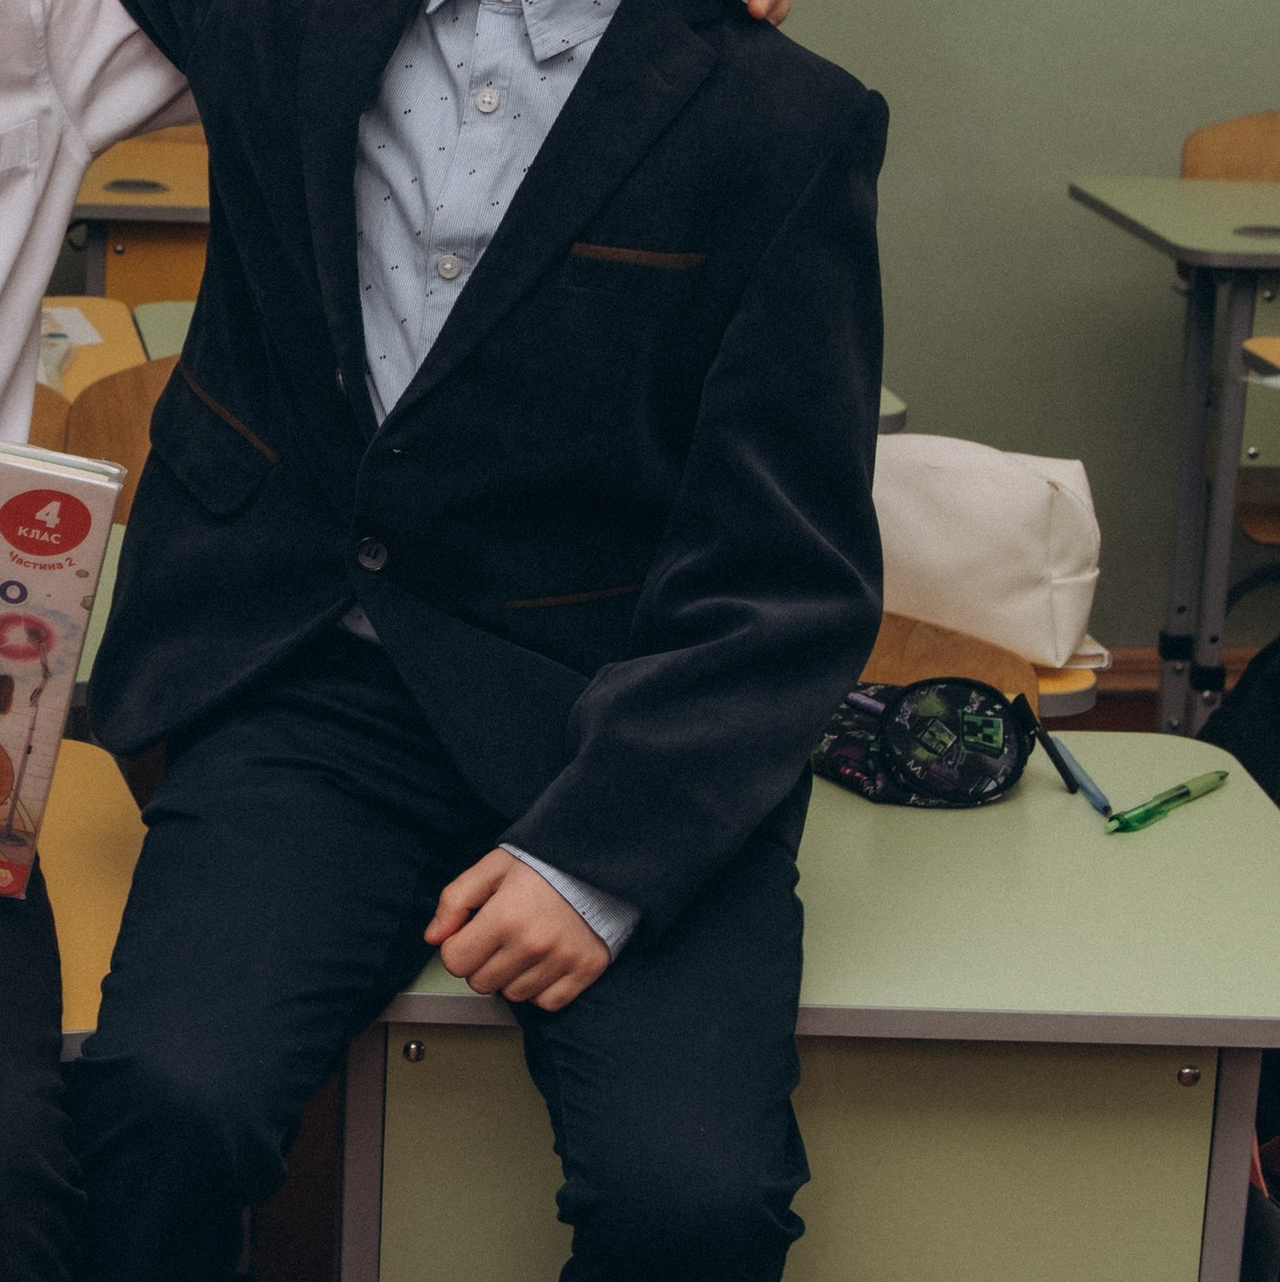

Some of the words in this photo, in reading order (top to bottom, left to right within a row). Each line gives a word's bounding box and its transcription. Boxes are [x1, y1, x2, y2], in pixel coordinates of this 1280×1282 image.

[34, 500, 62, 529] 4
[16, 526, 63, 545] КЛАС
[8, 549, 64, 572] Частина
[65, 556, 76, 568] 2
